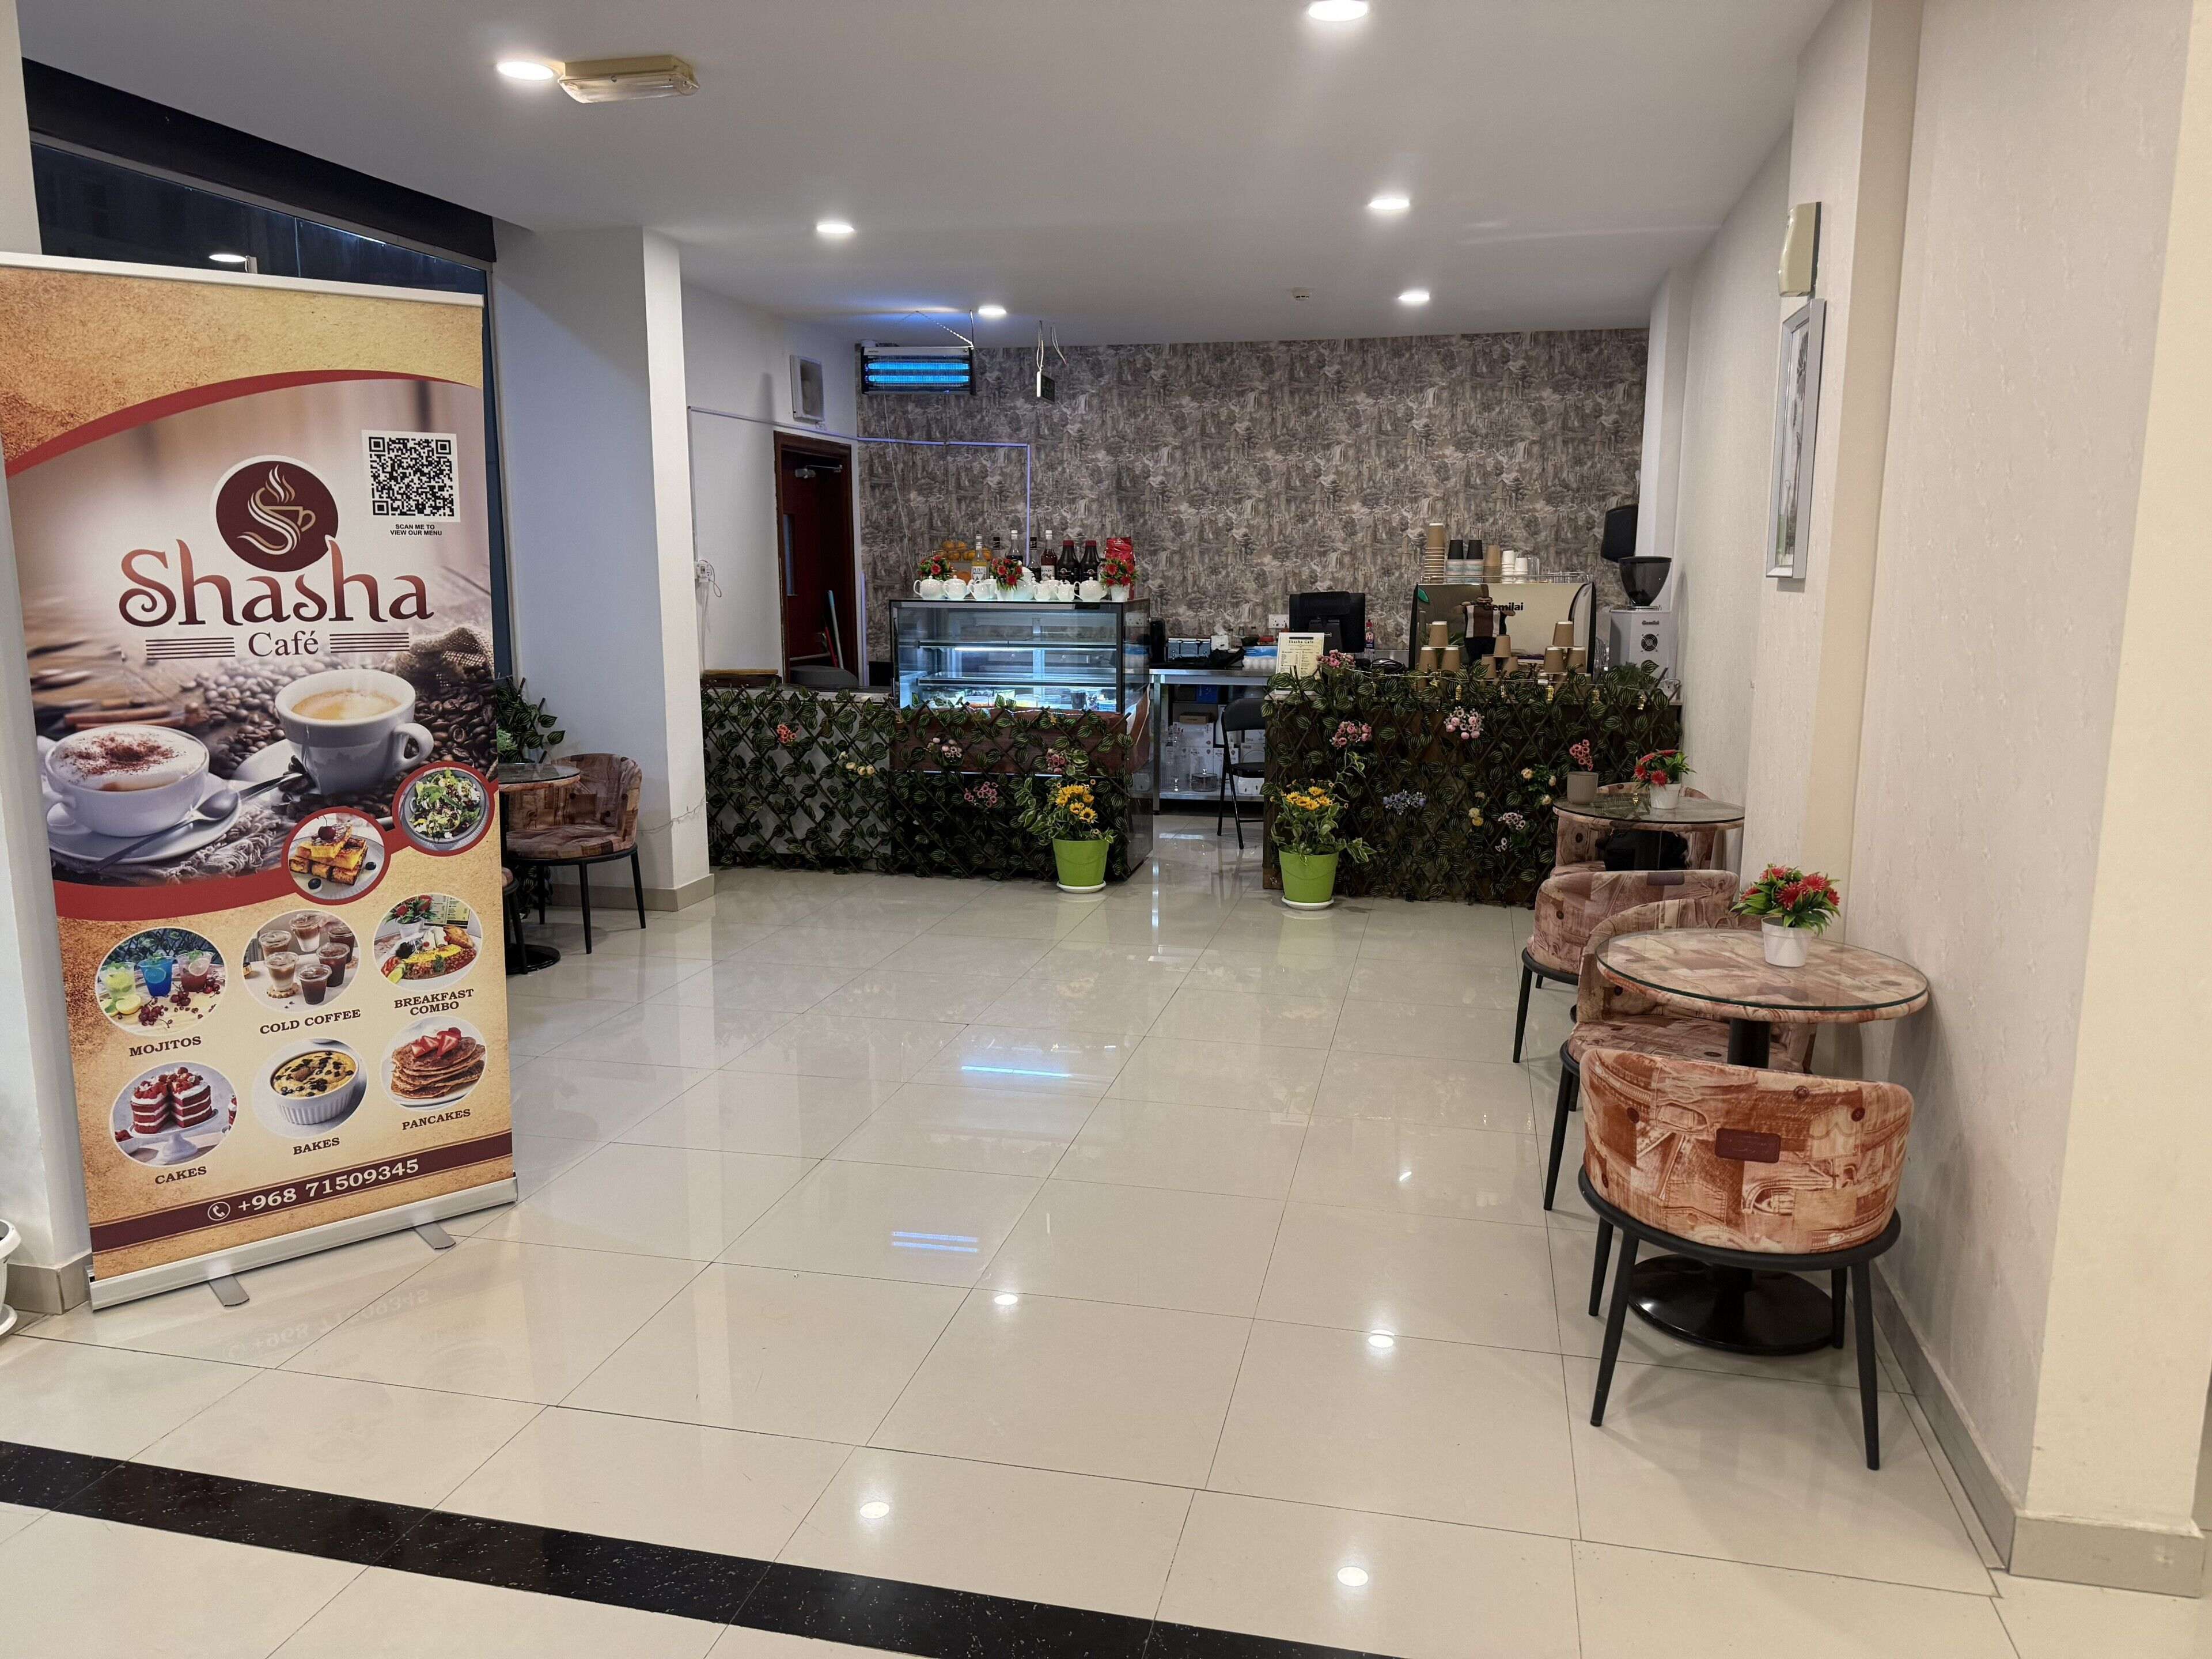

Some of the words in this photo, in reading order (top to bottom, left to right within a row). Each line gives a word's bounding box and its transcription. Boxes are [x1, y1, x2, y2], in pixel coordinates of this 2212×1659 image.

[119, 539, 434, 627] Shasha
[248, 630, 319, 657] Café
[393, 988, 474, 1009] BREAKFAST
[410, 1001, 460, 1016] COMBO
[259, 1020, 300, 1034] COLD
[304, 1009, 361, 1027] COFFEE
[128, 1036, 202, 1057] MOJITOS
[402, 1108, 471, 1130] PANCAKES
[293, 1137, 340, 1155] BAKES
[154, 1166, 207, 1184] CAKES
[238, 1188, 297, 1211] +968
[305, 1158, 419, 1198] 71509345
